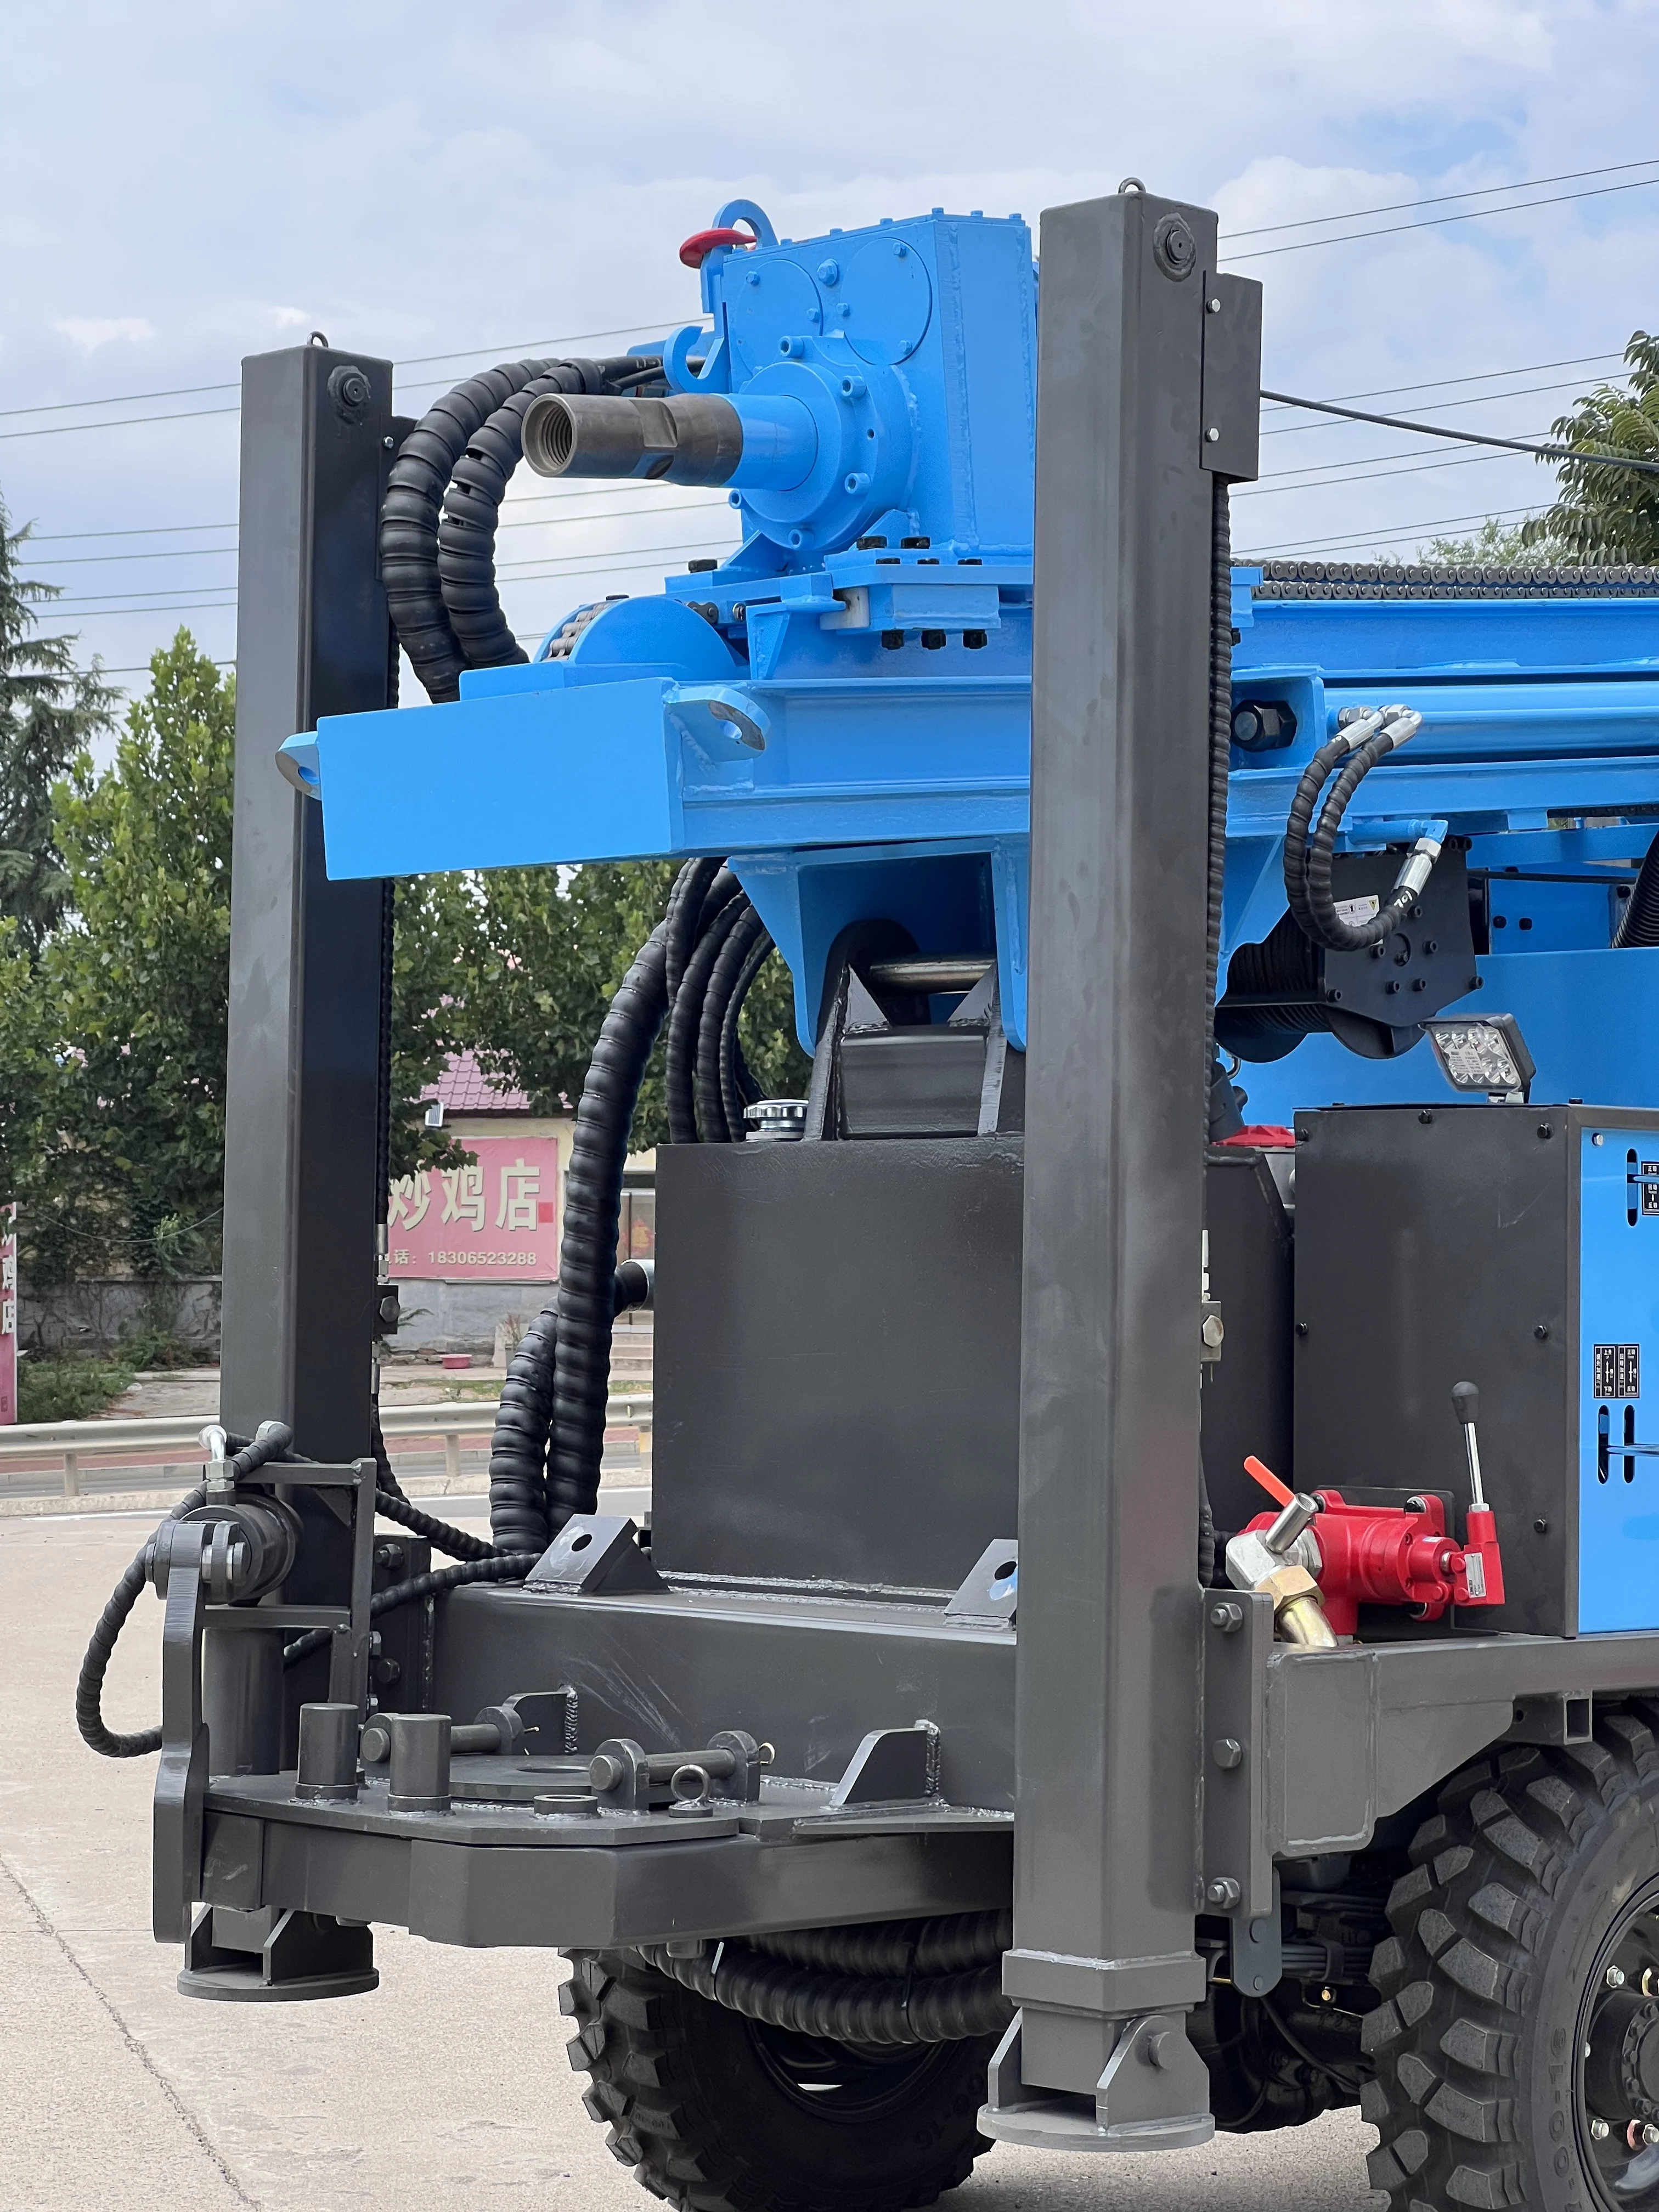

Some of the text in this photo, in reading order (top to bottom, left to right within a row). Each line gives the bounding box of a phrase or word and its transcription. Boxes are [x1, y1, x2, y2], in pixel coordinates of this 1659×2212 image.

[387, 1158, 540, 1232] 炒鸡店
[428, 1251, 537, 1265] 18306523288
